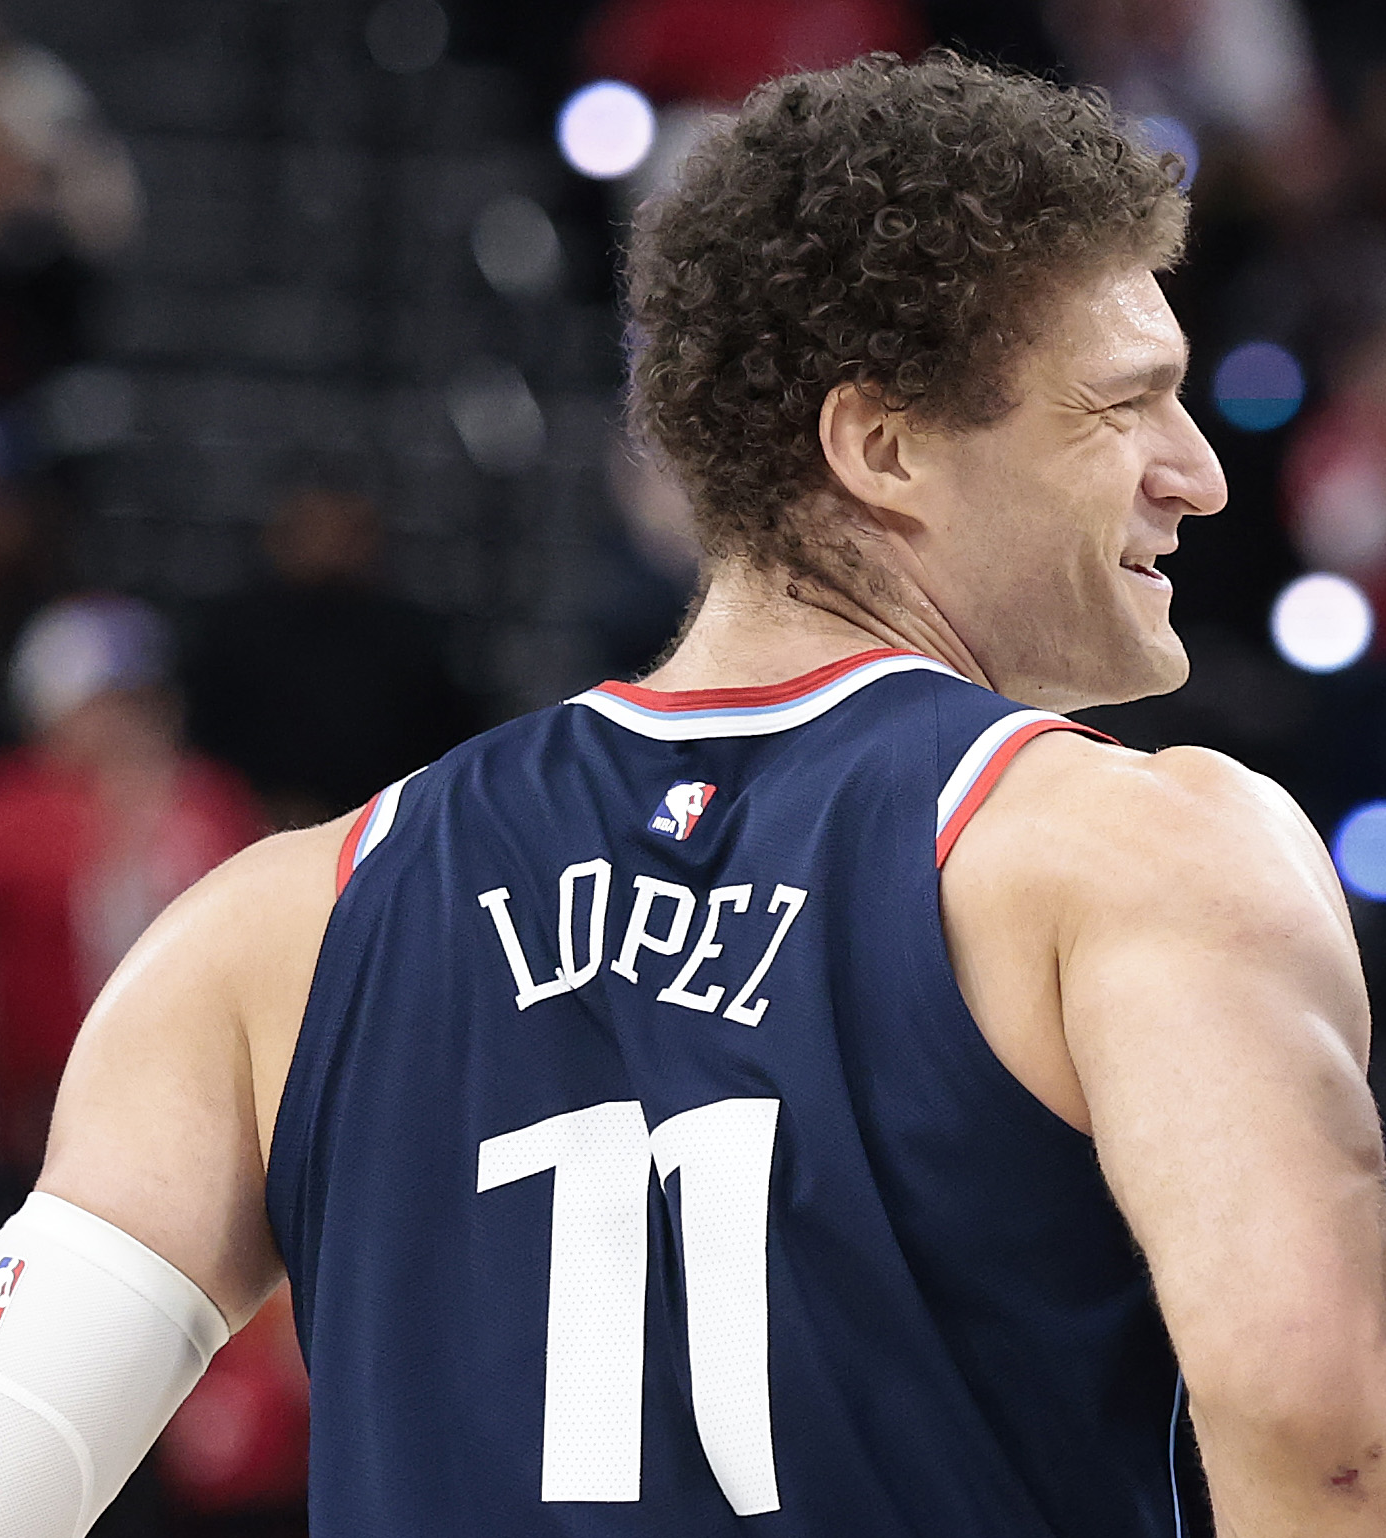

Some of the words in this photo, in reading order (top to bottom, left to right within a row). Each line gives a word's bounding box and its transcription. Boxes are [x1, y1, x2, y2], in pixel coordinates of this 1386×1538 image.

[652, 816, 677, 833] NBA
[477, 857, 808, 1027] LOPEZ
[477, 1098, 781, 1517] 11
